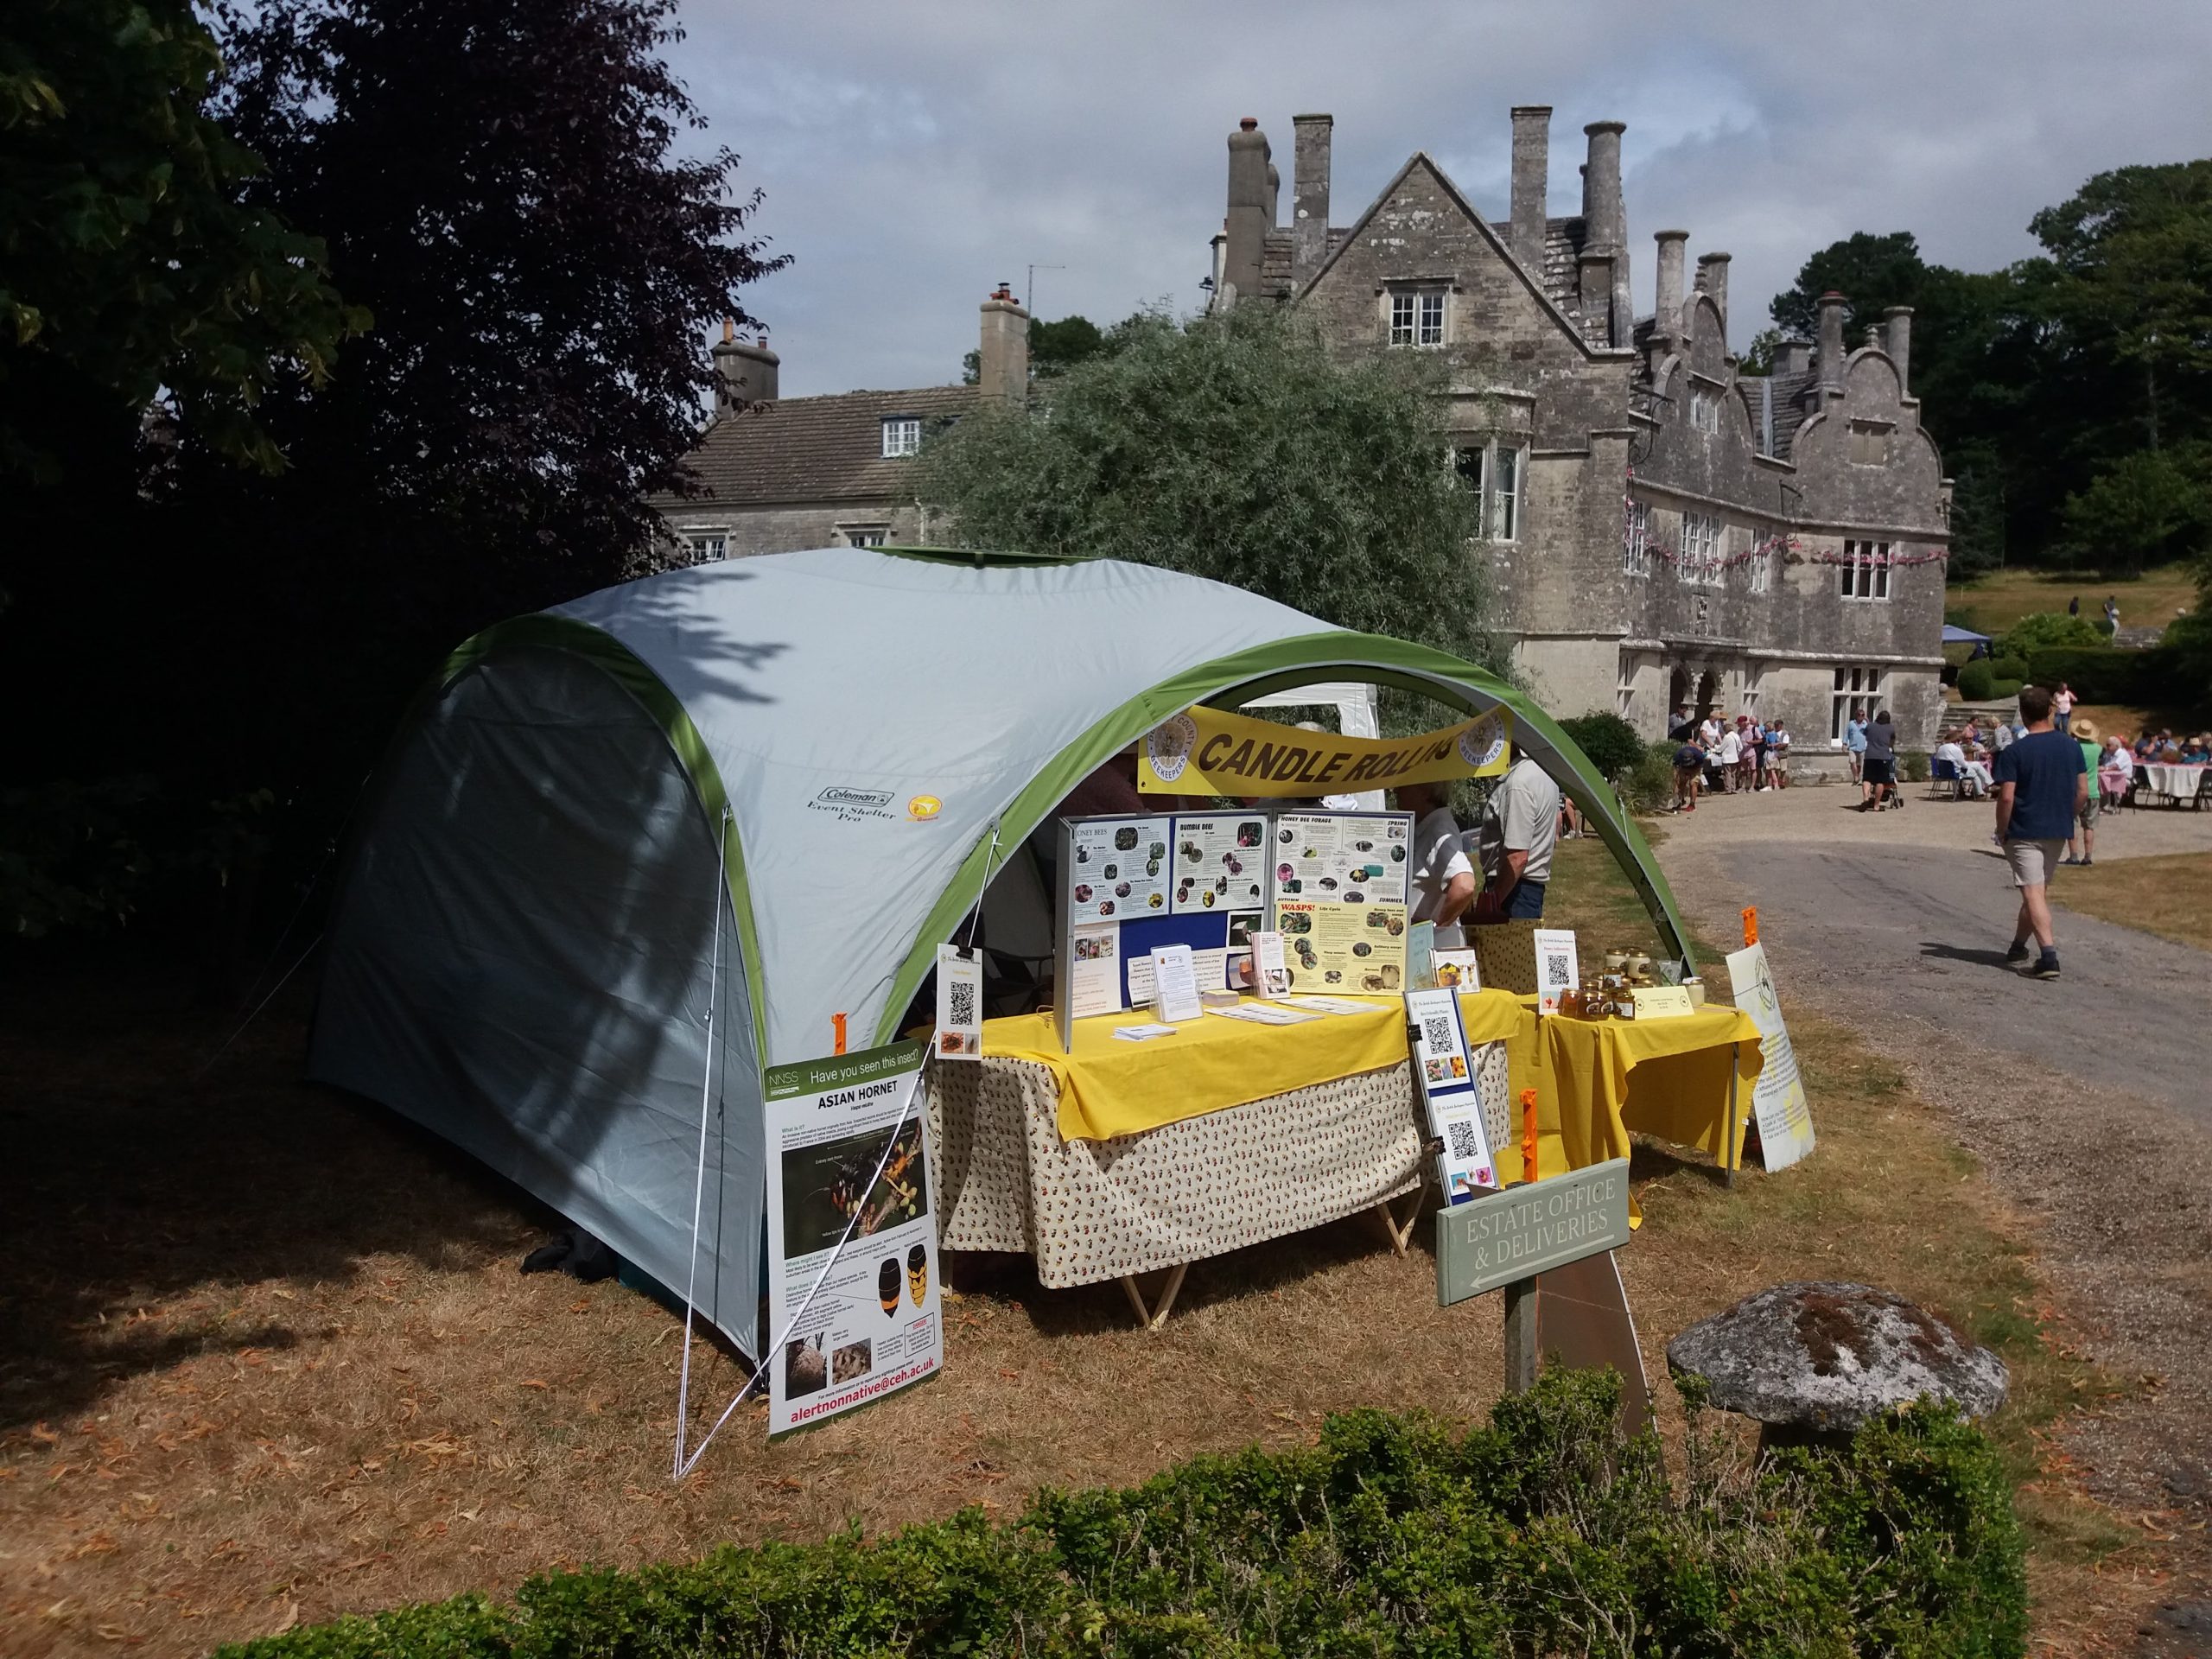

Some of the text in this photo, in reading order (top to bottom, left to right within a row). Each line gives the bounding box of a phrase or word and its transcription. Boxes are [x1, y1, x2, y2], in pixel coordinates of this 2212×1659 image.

[1178, 717, 1194, 745] COUNTY
[1150, 754, 1185, 779] BEEKEEPERS
[1198, 734, 1353, 783] CANDLE
[1461, 742, 1502, 765] BEEKEEPERS
[807, 800, 896, 820] Event Shelter
[826, 789, 876, 803] Coleman
[837, 813, 861, 822] Pro
[769, 1071, 799, 1086] NNSS
[810, 1048, 919, 1085] Have you seen this insect?
[818, 1090, 855, 1109] ASIAN
[858, 1081, 898, 1100] HORNET
[1467, 1178, 1616, 1243] ESTATE OFFICE
[1474, 1208, 1608, 1270] & DELIVERIES
[791, 1357, 934, 1423] alertnonnative@ceh.ac.uk
